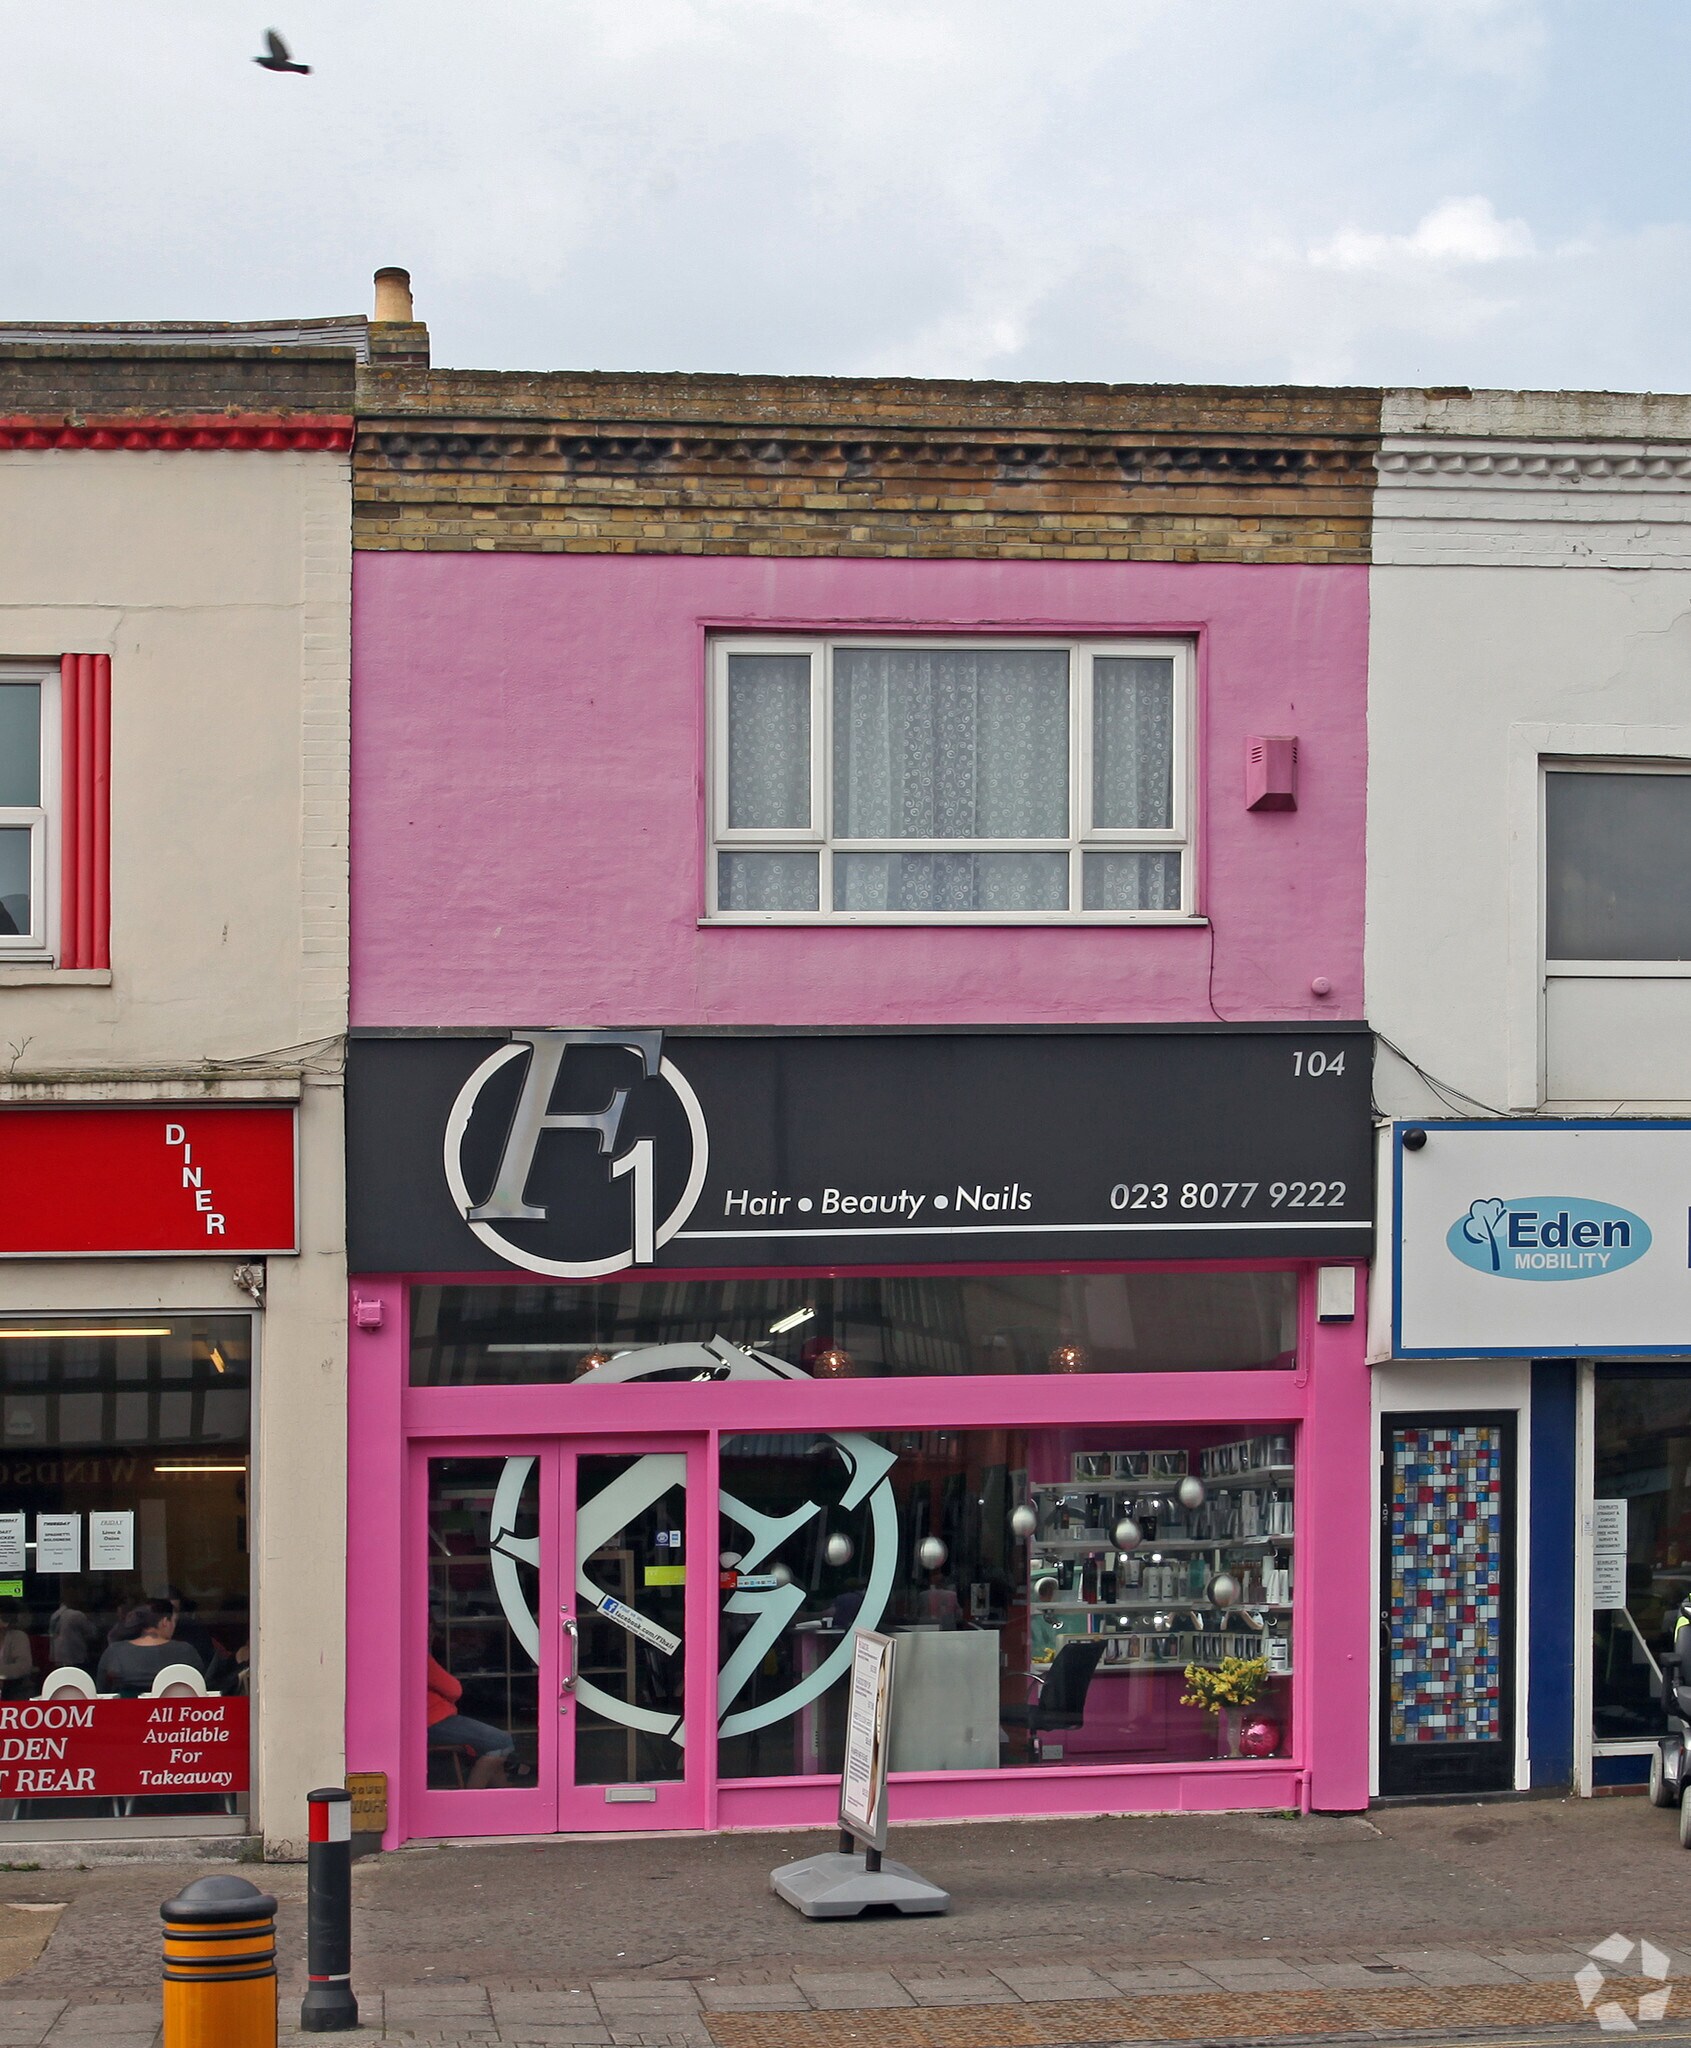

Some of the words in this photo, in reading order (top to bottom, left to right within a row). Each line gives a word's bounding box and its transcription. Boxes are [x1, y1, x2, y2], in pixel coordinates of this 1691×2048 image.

[1293, 1050, 1345, 1077] 104
[467, 1029, 664, 1264] F1
[165, 1123, 226, 1235] DINER
[724, 1189, 791, 1216] Hair
[821, 1187, 927, 1219] Beauty
[954, 1183, 1033, 1212] Nails
[1109, 1183, 1169, 1209] 023
[1180, 1182, 1259, 1209] 8077
[1269, 1181, 1346, 1208] 9222
[1507, 1212, 1631, 1248] Eden
[1515, 1253, 1611, 1269] MOBILITY
[0, 1705, 96, 1729] ROOM
[147, 1707, 173, 1723] All
[178, 1706, 225, 1722] Food
[142, 1727, 230, 1744] Available
[169, 1748, 203, 1764] For
[15, 1768, 96, 1792] REAR
[139, 1770, 232, 1787] Takeaway
